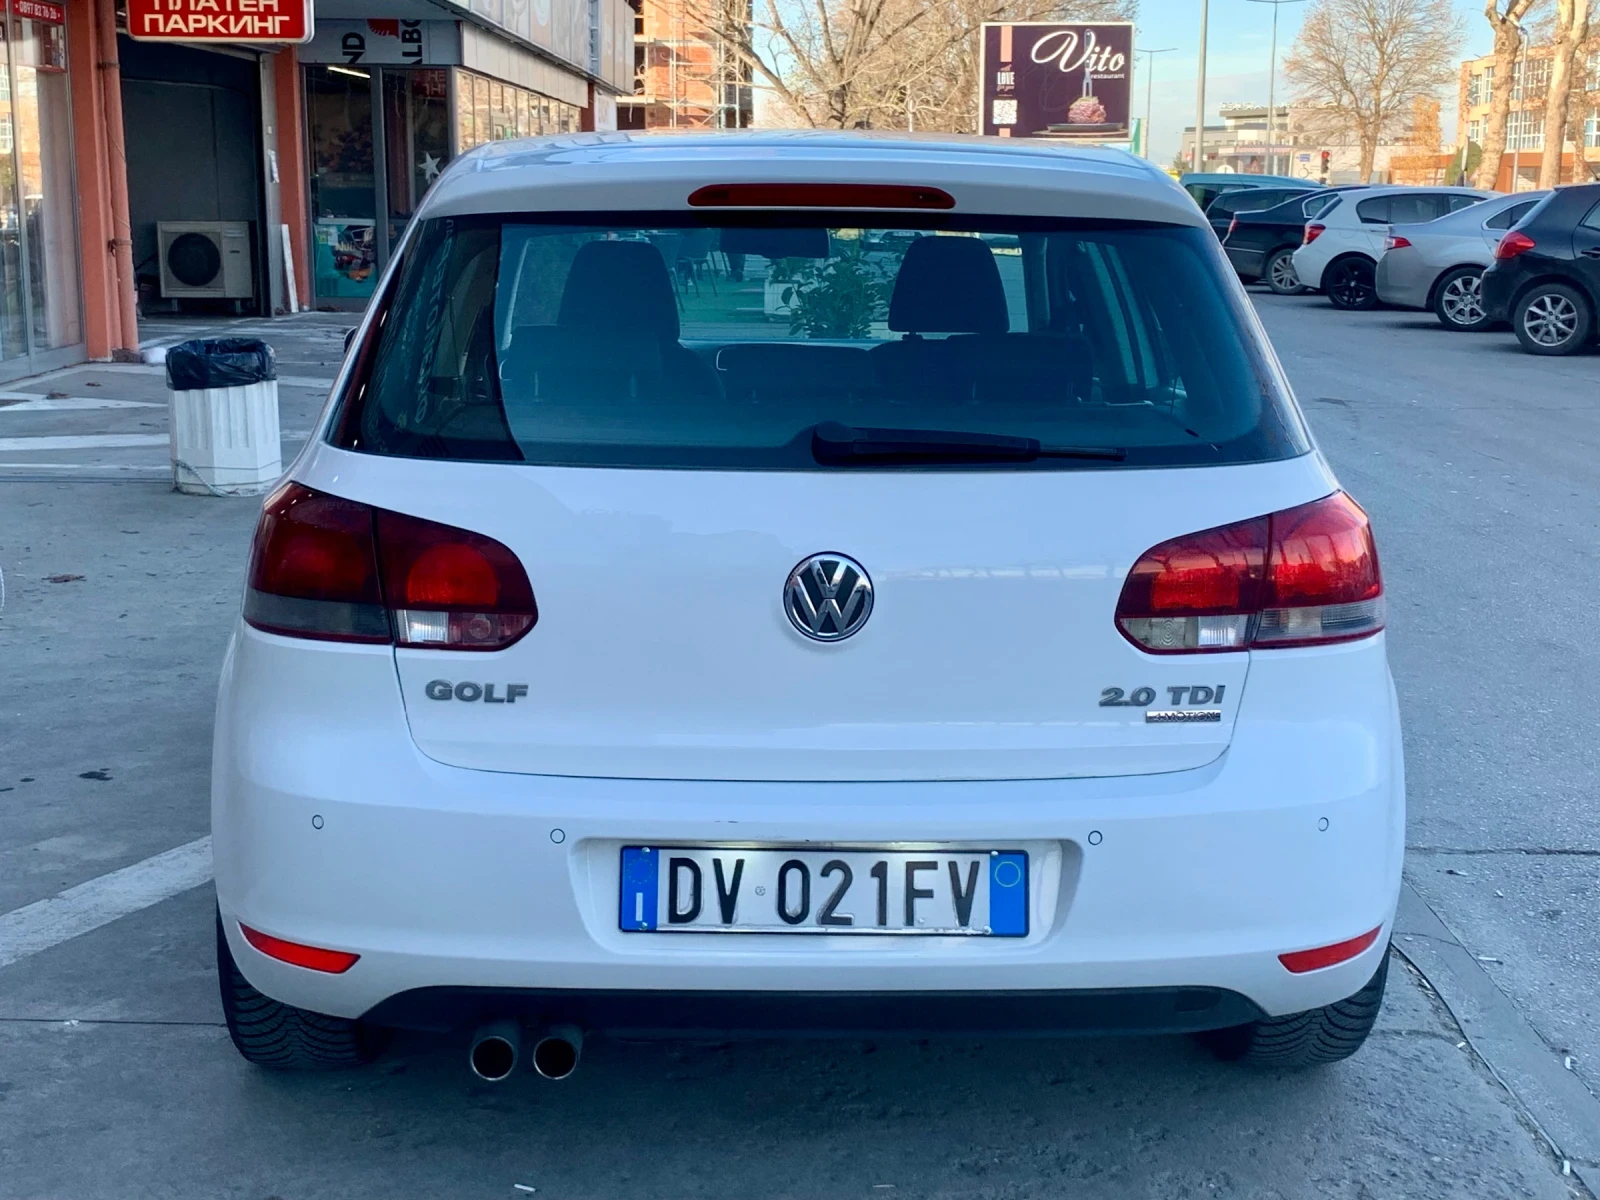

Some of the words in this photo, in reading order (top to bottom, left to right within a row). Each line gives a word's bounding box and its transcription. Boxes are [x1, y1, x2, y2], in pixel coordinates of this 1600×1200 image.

[144, 14, 290, 34] ПАРКИНГ
[1031, 30, 1125, 72] Vito
[997, 72, 1015, 85] LOVE
[425, 680, 528, 703] GOLF
[1100, 686, 1157, 707] 2.0
[1166, 684, 1226, 706] TDI
[1153, 712, 1217, 722] 4MOTION
[668, 857, 745, 924] DV
